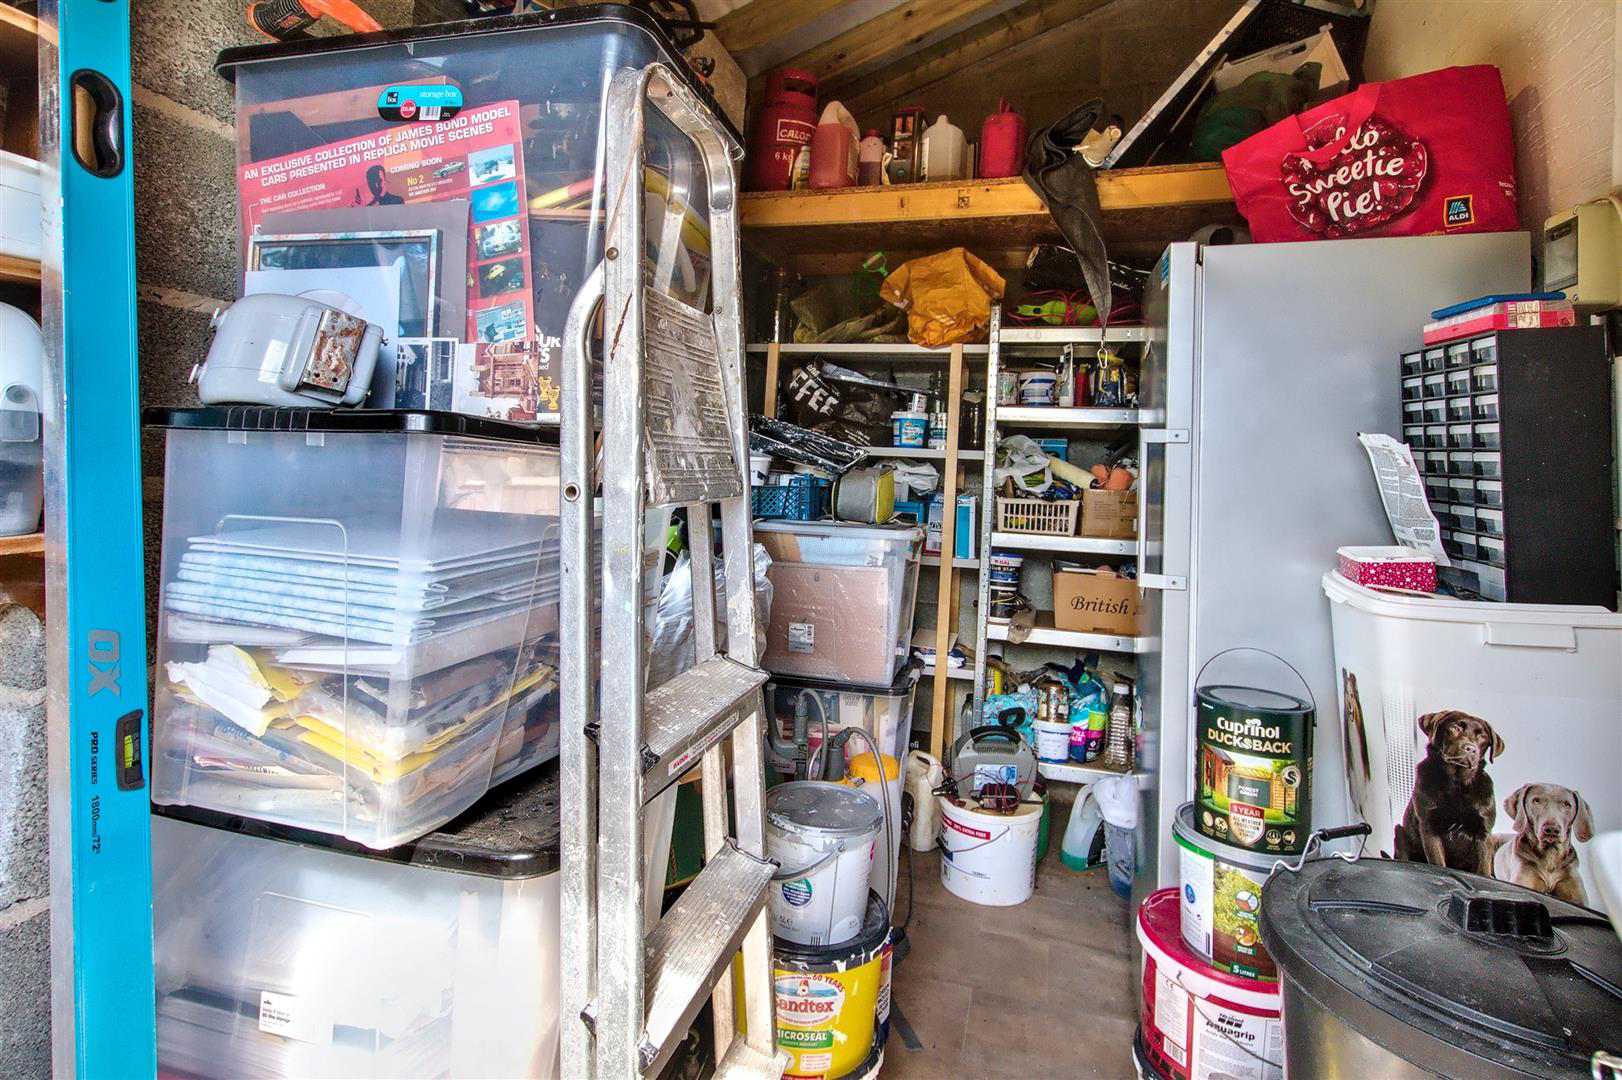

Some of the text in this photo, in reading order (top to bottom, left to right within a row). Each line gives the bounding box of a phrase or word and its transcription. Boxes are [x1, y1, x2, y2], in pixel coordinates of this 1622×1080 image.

[244, 107, 512, 181] AN EXCLUSIVE COLLECTION OF JAMES BOND MODEL
[261, 123, 493, 187] CARS PRESENTED IN REPLICA MOVIE SCENES
[774, 152, 780, 160] 6
[390, 156, 443, 174] COMING SOON
[407, 175, 424, 187] No 2
[260, 183, 326, 205] THE CAR COLLECTION
[1448, 212, 1469, 221] ALDI
[1070, 595, 1129, 615] British
[87, 628, 121, 699] OX
[1216, 717, 1280, 739] Cuprinol
[90, 731, 99, 754] PRO
[1239, 807, 1261, 817] YEAR
[1233, 964, 1240, 973] 5
[825, 976, 846, 992] YEARS
